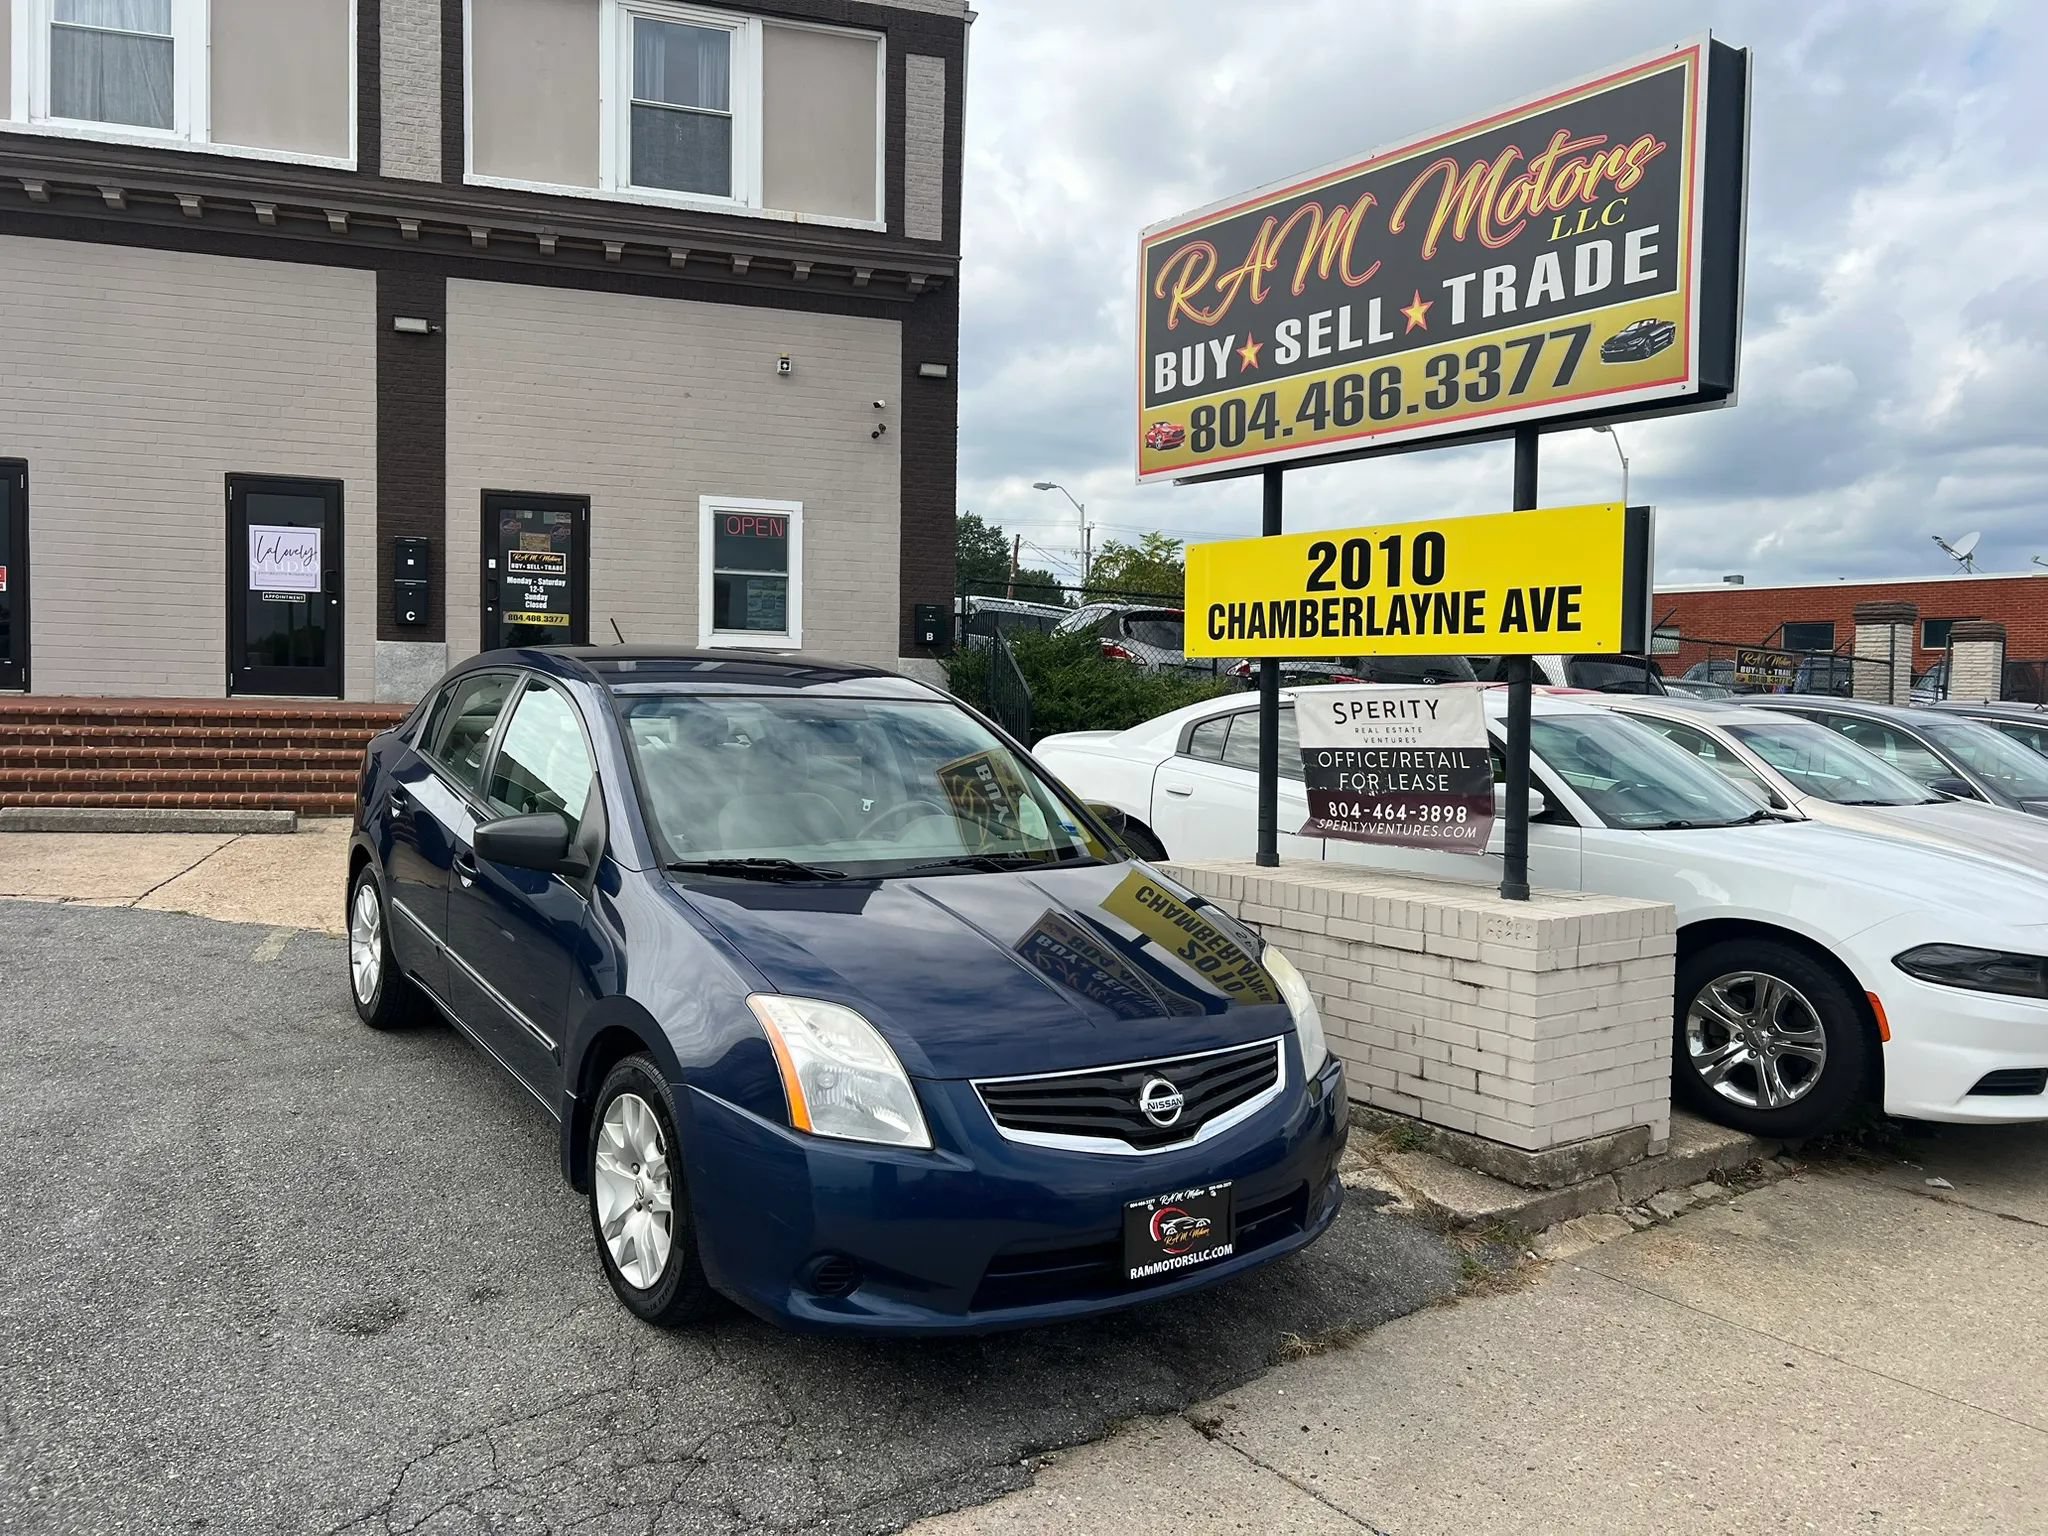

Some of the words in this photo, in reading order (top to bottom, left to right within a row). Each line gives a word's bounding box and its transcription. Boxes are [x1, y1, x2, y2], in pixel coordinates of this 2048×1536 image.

[1155, 192, 1381, 330] RAM
[1389, 128, 1665, 260] Motors
[1547, 197, 1628, 242] LLC
[1155, 334, 1236, 394] BUY
[1275, 297, 1393, 366] SELL
[1443, 224, 1660, 324] TRADE
[1190, 324, 1592, 454] 804.466.3377
[726, 516, 784, 537] OPEN
[1306, 531, 1445, 592] 2010
[507, 576, 532, 586] Monday
[538, 578, 566, 587] Saturday
[524, 593, 548, 602] Sunday
[406, 611, 416, 621] C
[1208, 590, 1487, 642] CHAMBERLAYNE
[1500, 586, 1582, 633] AVE
[926, 632, 934, 641] B
[1333, 699, 1439, 725] SPERITY
[1386, 726, 1423, 734] ESTATE
[1318, 751, 1470, 769] OFFICE/RETAIL
[1339, 773, 1379, 791] FOR
[1388, 773, 1449, 791] LEASE
[1328, 801, 1468, 823] 804-464-3898
[1316, 818, 1477, 838] SPERITYVENTURES.COM
[1147, 1096, 1183, 1110] NISSAN
